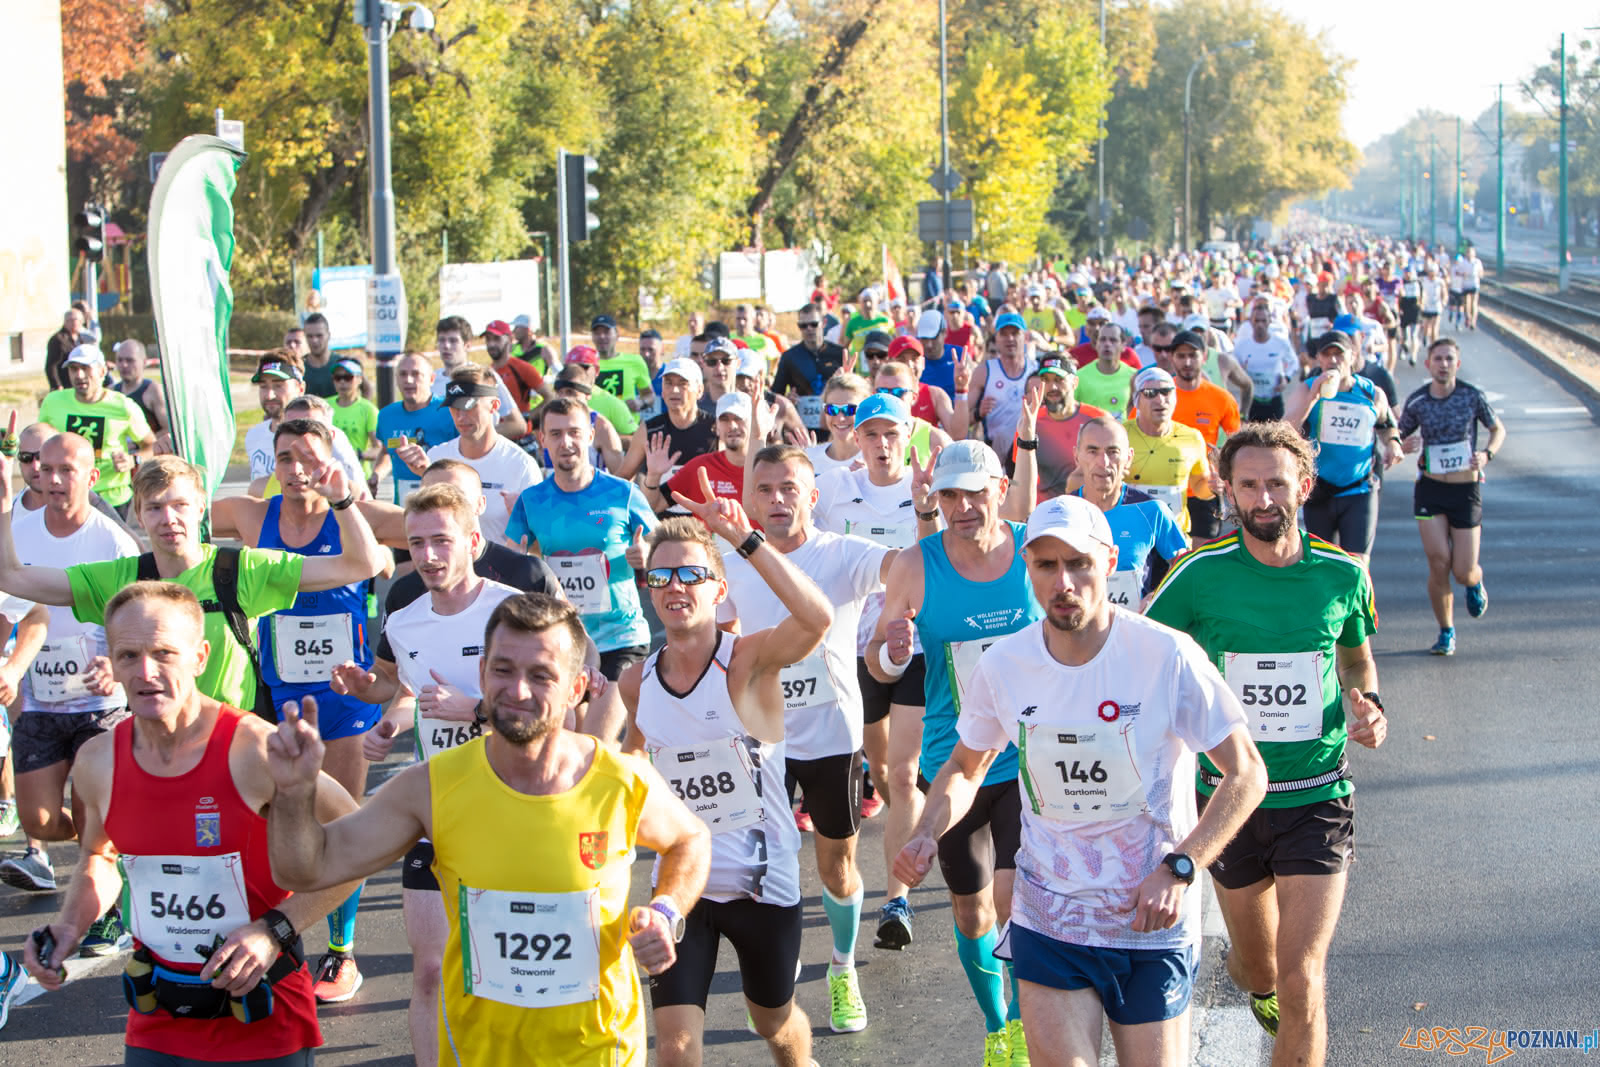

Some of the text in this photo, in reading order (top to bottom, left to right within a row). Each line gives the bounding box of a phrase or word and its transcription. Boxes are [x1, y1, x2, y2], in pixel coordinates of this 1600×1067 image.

[1330, 416, 1361, 429] 2347
[1440, 456, 1463, 469] 1227
[295, 639, 333, 656] 845
[35, 660, 78, 677] 4440
[1242, 684, 1307, 706] 5302
[1021, 706, 1038, 716] 4F
[1055, 760, 1108, 783] 146
[670, 771, 735, 800] 3688
[1064, 788, 1107, 796] Bartłomiej
[695, 803, 718, 812] Jakub
[151, 892, 226, 921] 5466
[166, 925, 210, 935] Waldemar
[494, 932, 572, 961] 1292
[510, 966, 556, 977] Sławomir
